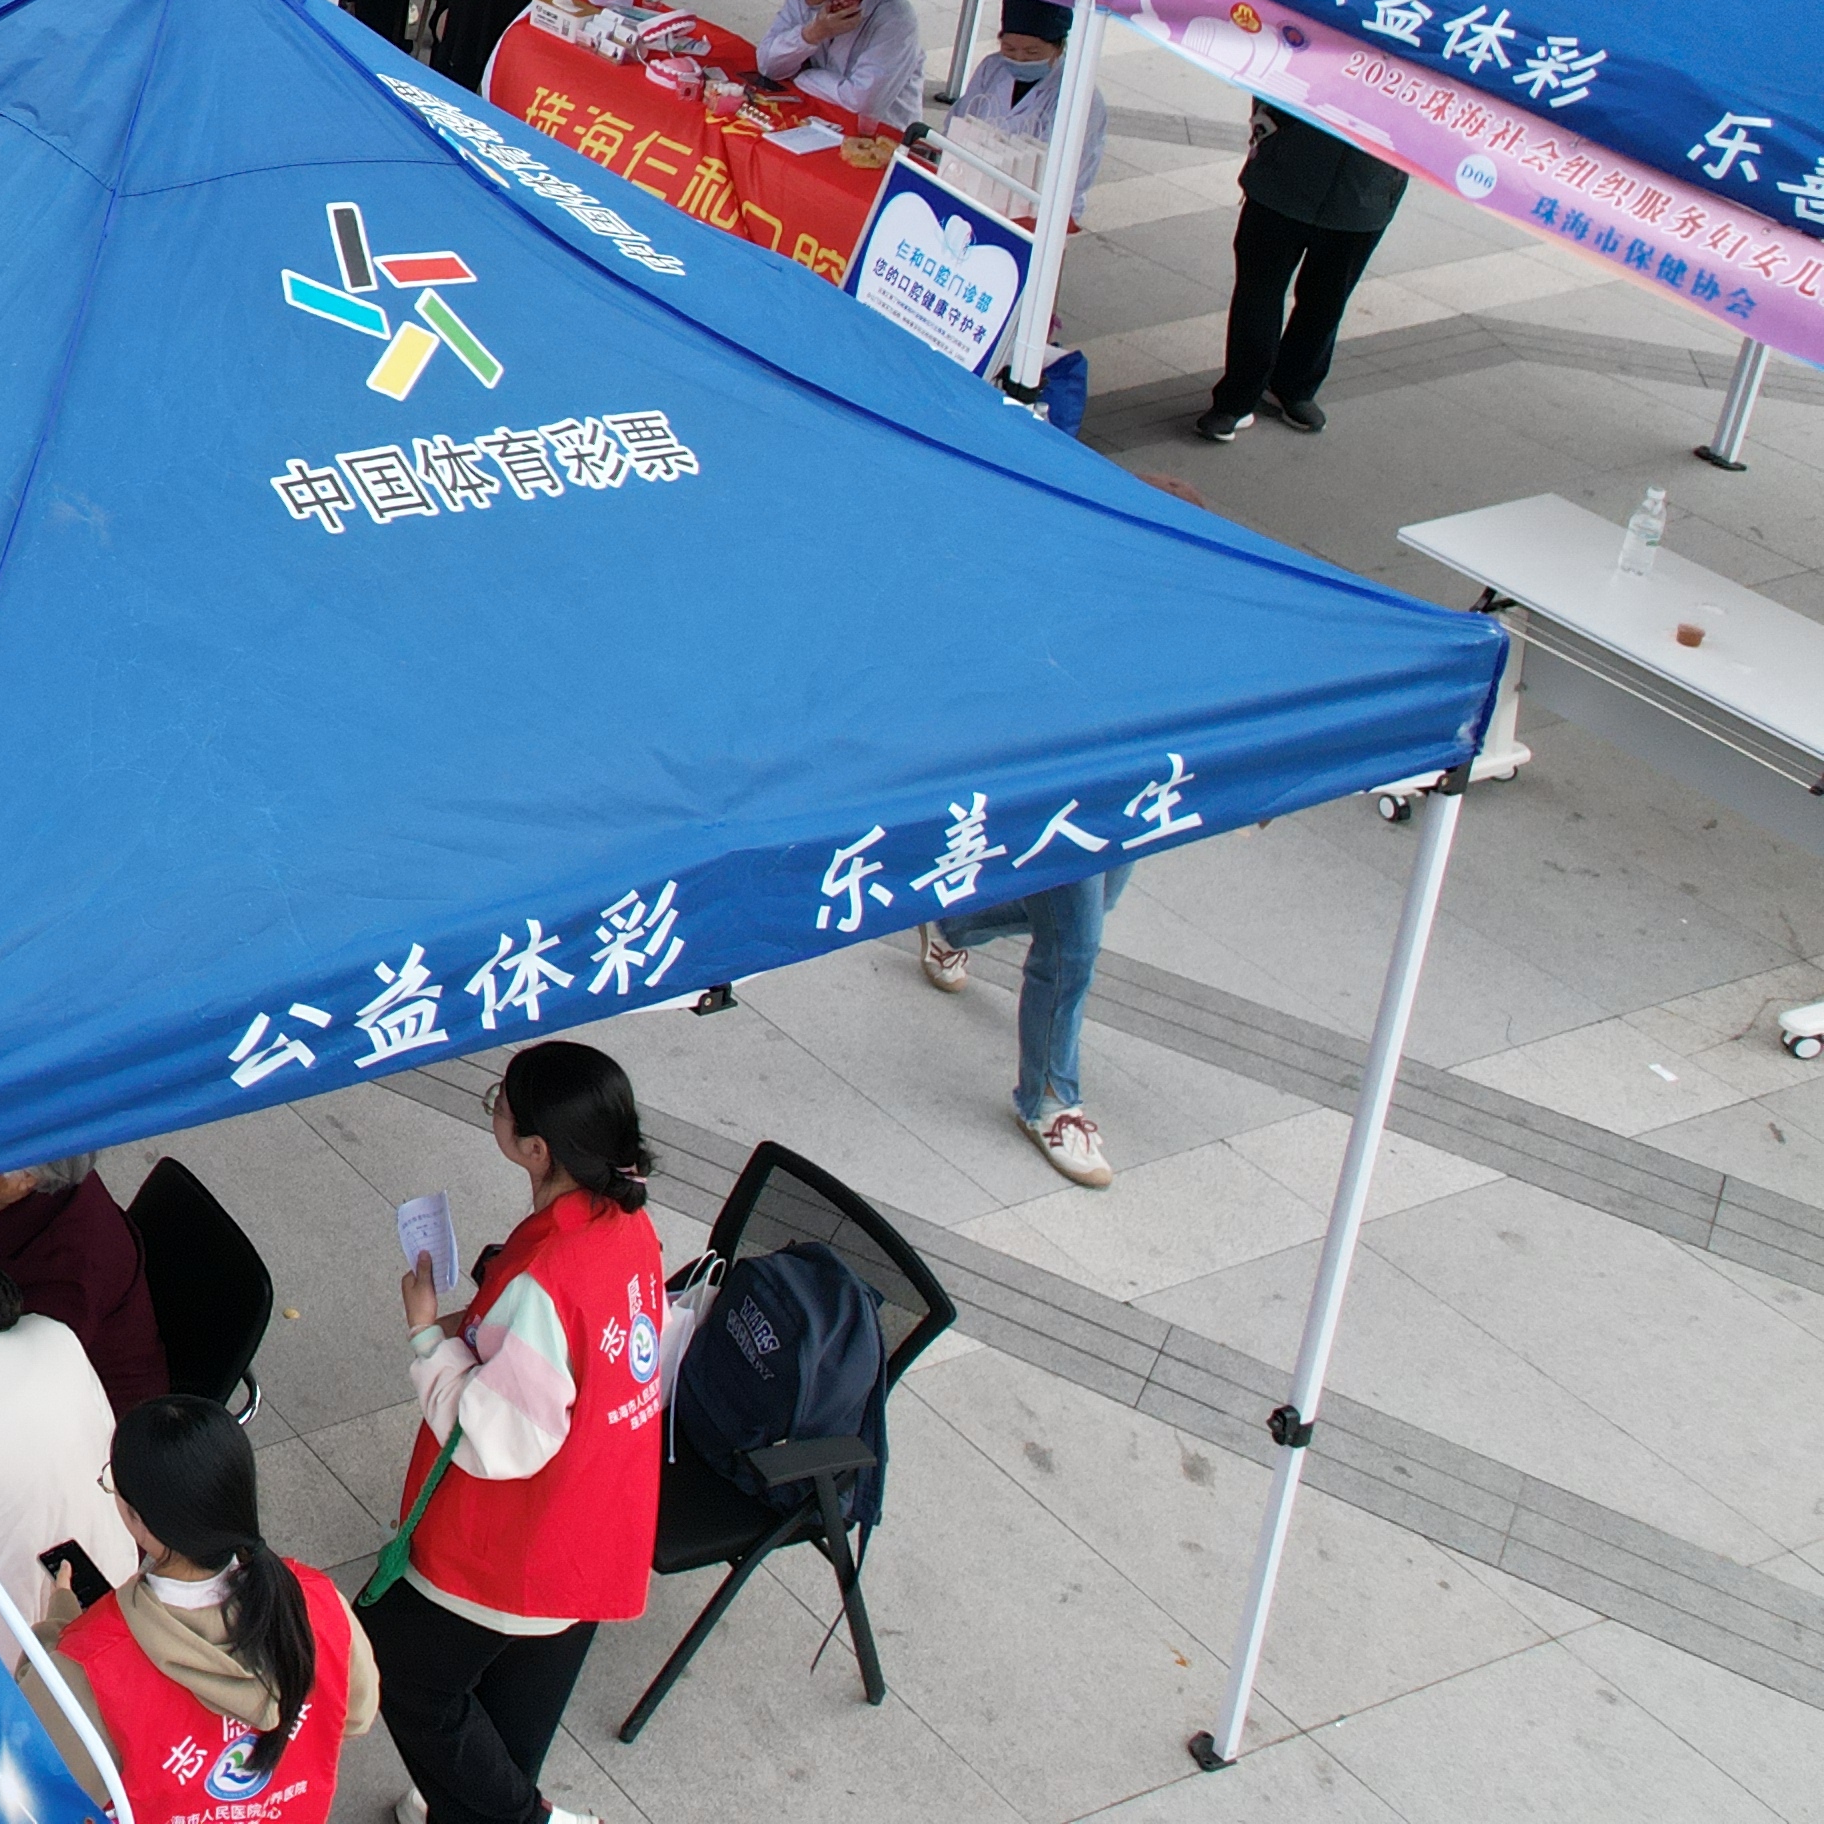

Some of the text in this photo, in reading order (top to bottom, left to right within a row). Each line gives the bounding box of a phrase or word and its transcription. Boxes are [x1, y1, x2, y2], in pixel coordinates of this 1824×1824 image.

[1461, 162, 1496, 191] D06
[872, 256, 988, 345] 您的口腔健康守护者
[895, 237, 994, 315] 仁和口腔门诊部
[1529, 193, 1760, 321] 珠海市保健协会
[270, 408, 703, 537] 中国体育彩票
[229, 752, 1204, 1090] 公益体彩 乐善人生
